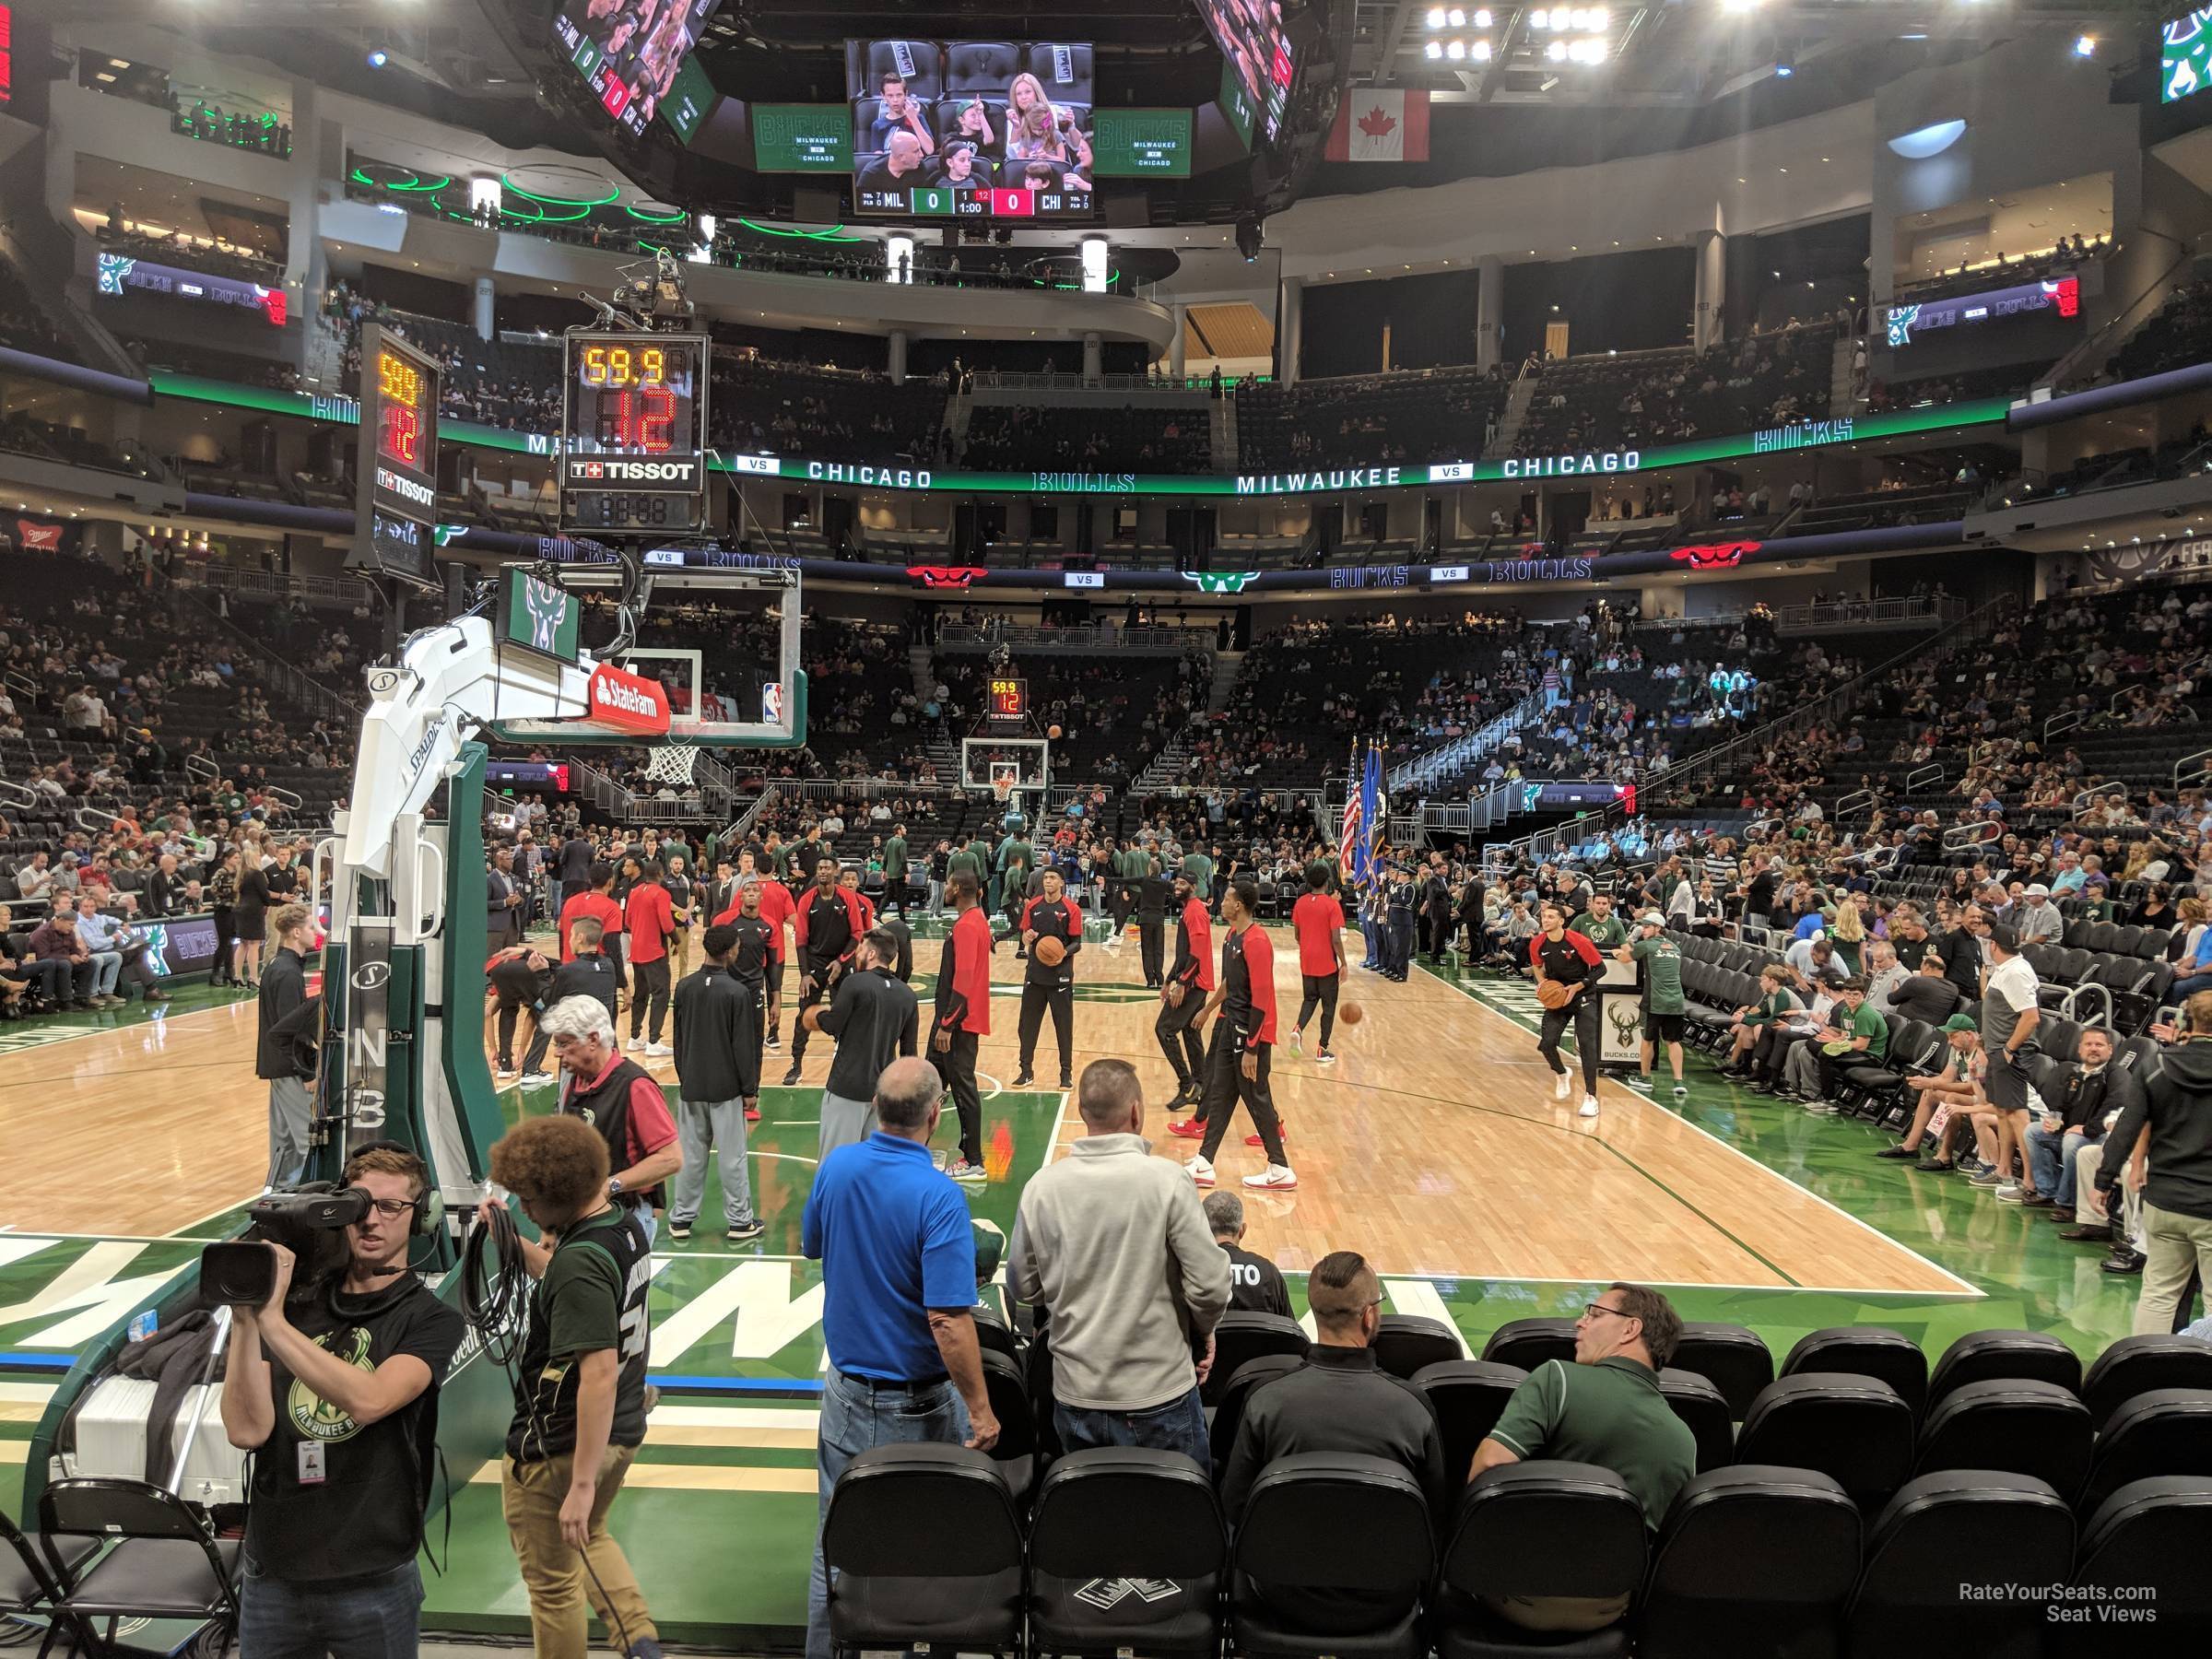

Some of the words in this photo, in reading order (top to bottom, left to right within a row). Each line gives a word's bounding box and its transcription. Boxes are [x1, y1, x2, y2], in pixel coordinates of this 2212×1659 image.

[582, 51, 594, 67] 0
[612, 90, 622, 106] 0
[885, 193, 903, 206] MIL
[928, 193, 938, 208] 0
[962, 191, 967, 200] 1
[1008, 194, 1018, 209] 0
[1042, 195, 1061, 209] CHI
[959, 203, 982, 213] 1:00
[587, 347, 664, 383] 59.9
[622, 388, 676, 450] 12
[395, 408, 418, 461] 12
[1755, 418, 1853, 453] BUCKS
[605, 462, 695, 479] TISSOT
[749, 461, 767, 470] VS
[809, 462, 932, 488] CHICAGO
[1237, 466, 1401, 493] MILWAUKEE
[1442, 467, 1460, 477] VS
[1504, 451, 1641, 477] CHICAGO
[1032, 472, 1135, 492] BULLS
[394, 477, 434, 506] TISSOT
[29, 529, 53, 542] Miller
[657, 553, 672, 561] VS
[1077, 575, 1092, 584] VS
[1331, 565, 1408, 588] BUCKS
[1441, 570, 1457, 578] VS
[1488, 558, 1592, 582] BULLS
[993, 682, 1016, 693] 59.9
[1002, 693, 1019, 711] 12
[296, 1406, 345, 1436] MILWAUKEE
